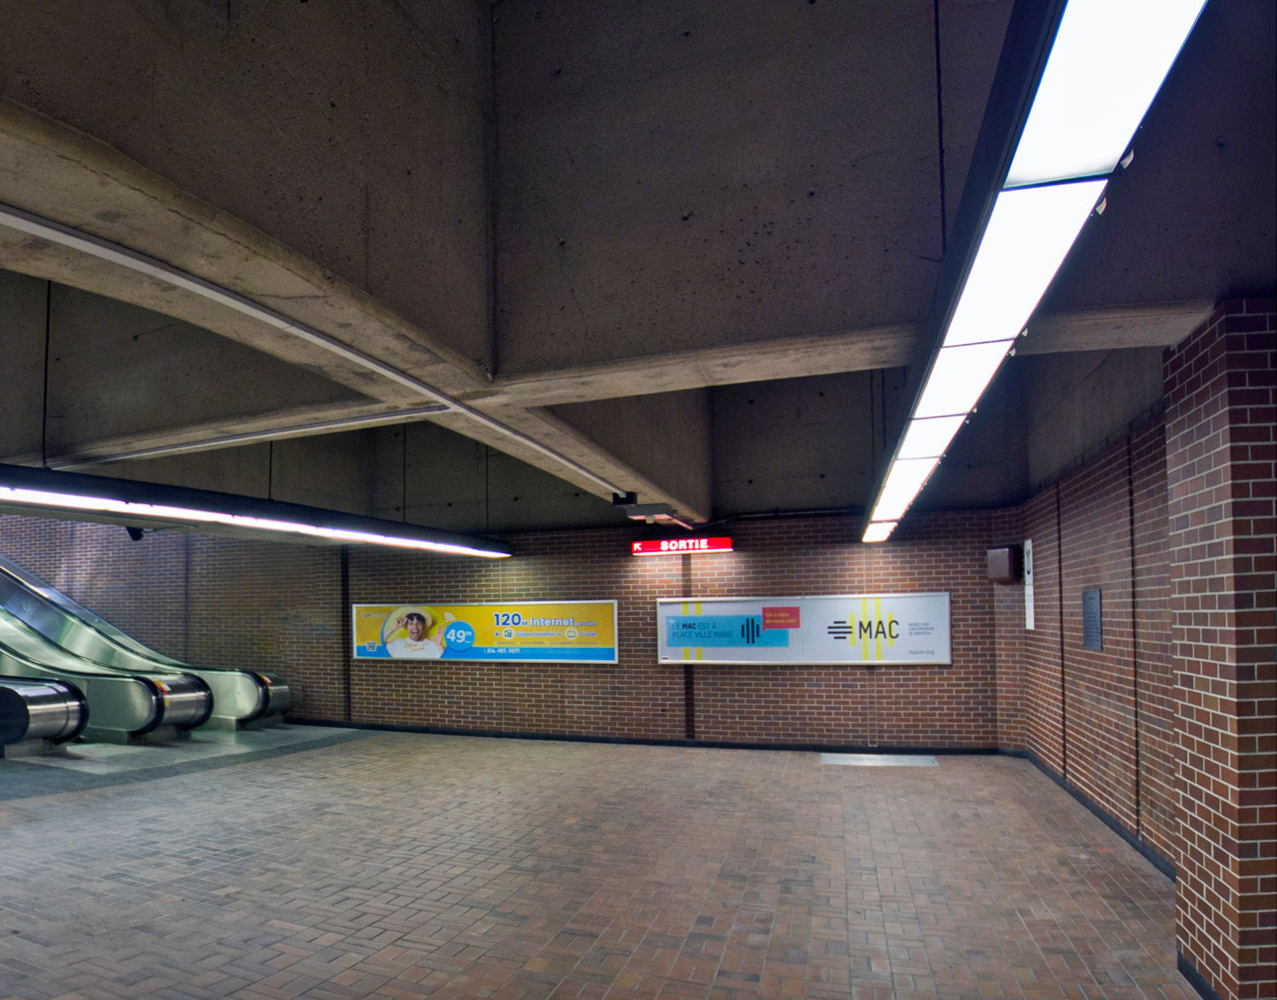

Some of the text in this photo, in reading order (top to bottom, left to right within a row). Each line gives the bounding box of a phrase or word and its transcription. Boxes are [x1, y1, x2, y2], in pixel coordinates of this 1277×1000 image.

[660, 539, 709, 551] SORTIE
[493, 612, 522, 626] 120
[530, 616, 575, 627] Internet
[682, 622, 697, 630] MAC
[858, 620, 900, 639] MAC
[672, 631, 734, 639] PLACE VILLE MARIE
